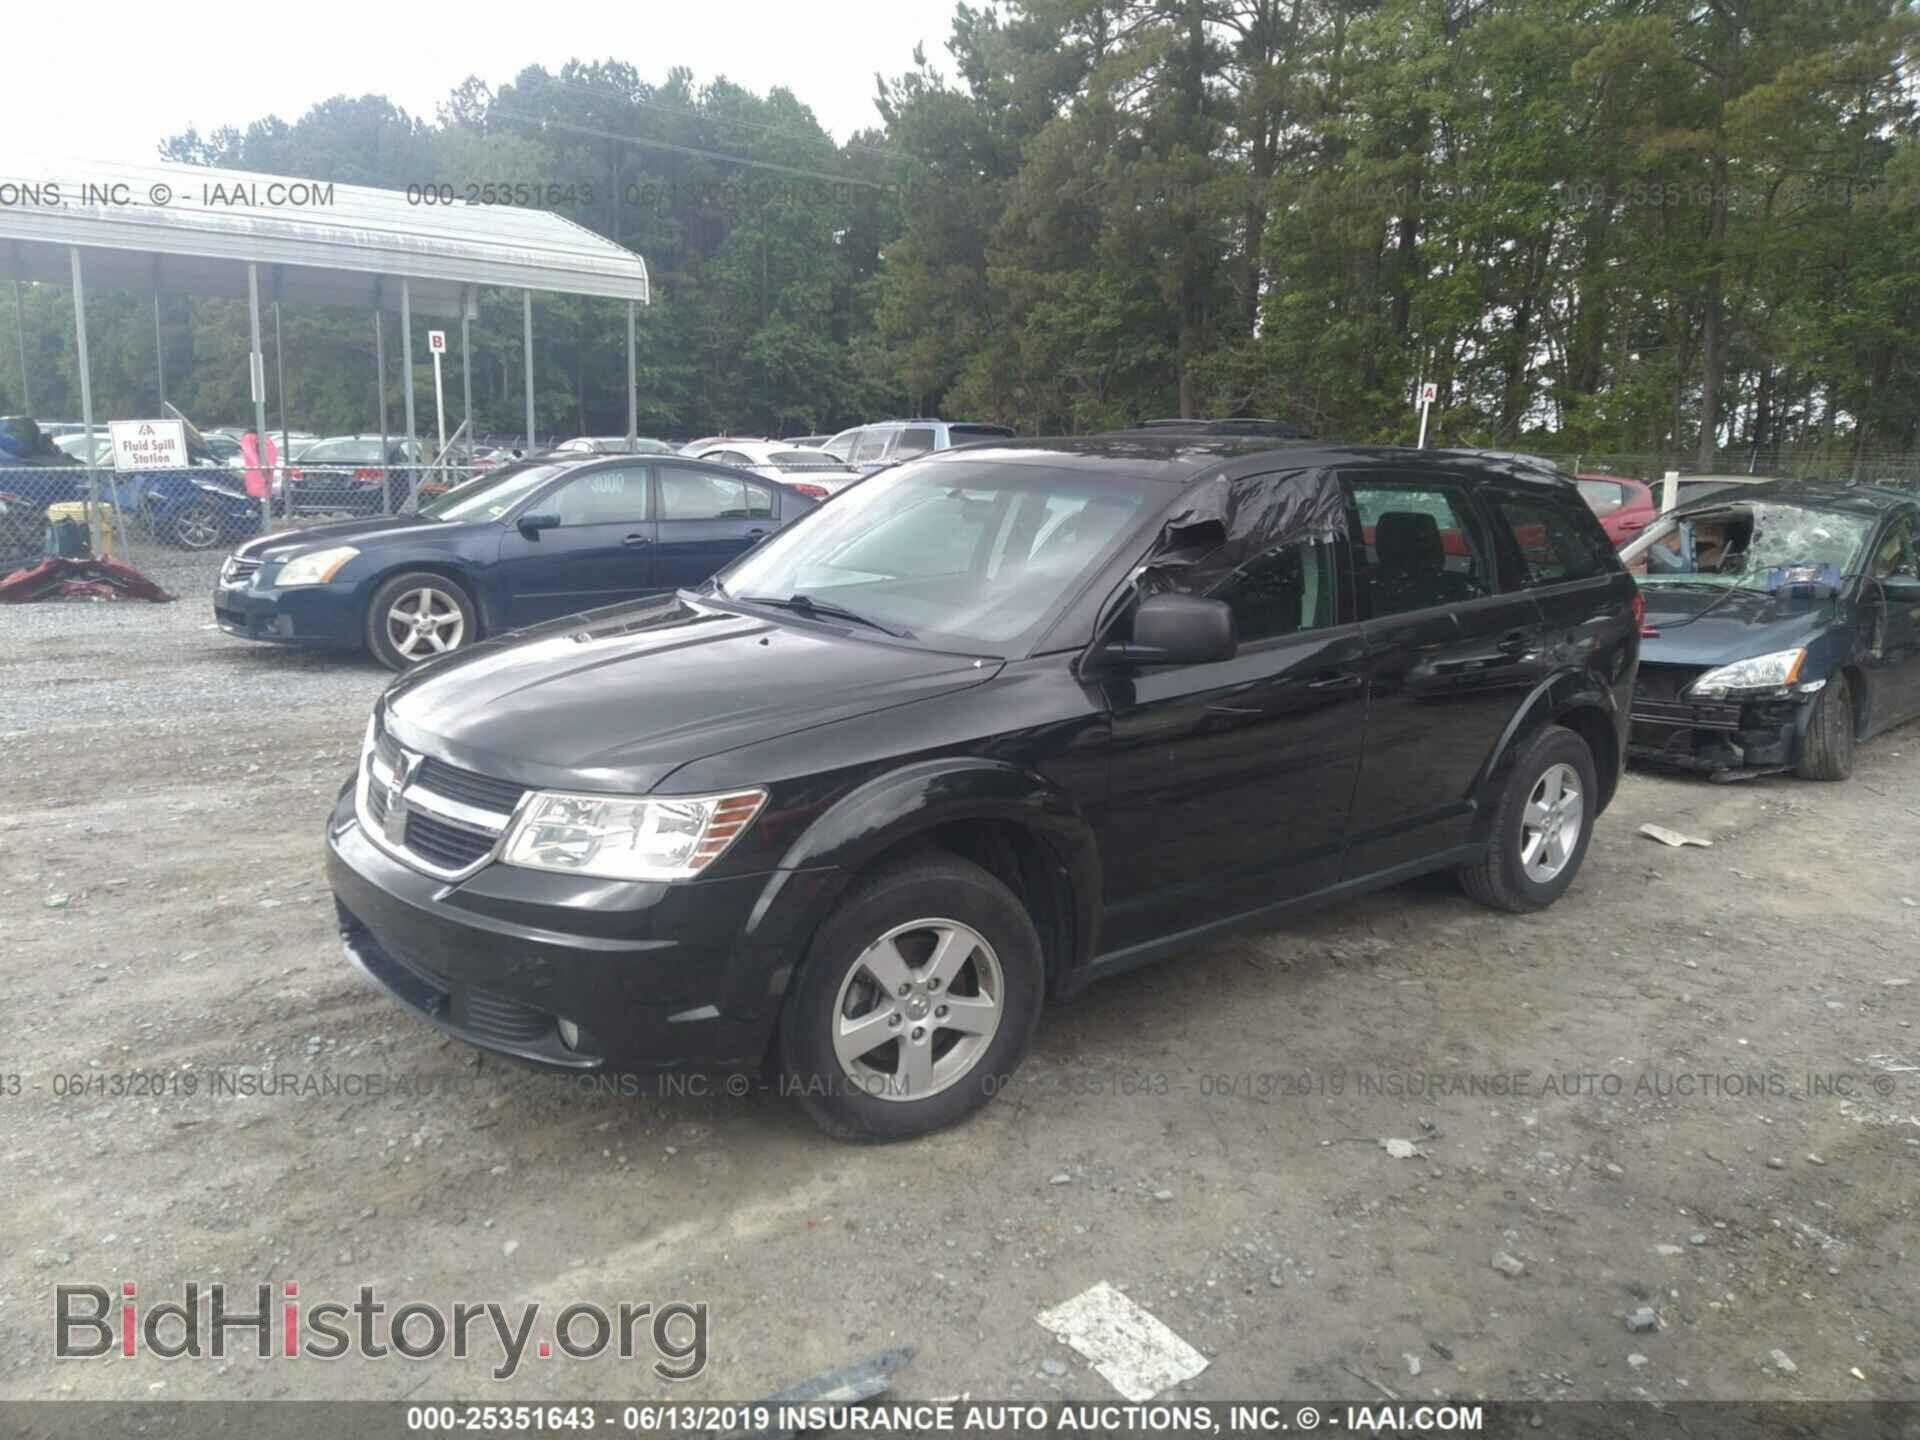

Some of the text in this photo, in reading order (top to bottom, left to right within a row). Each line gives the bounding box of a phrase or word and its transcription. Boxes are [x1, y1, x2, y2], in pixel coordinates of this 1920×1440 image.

[432, 335, 443, 348] B
[1424, 386, 1434, 399] A
[123, 439, 176, 453] Fluid Spill
[133, 453, 170, 465] Station
